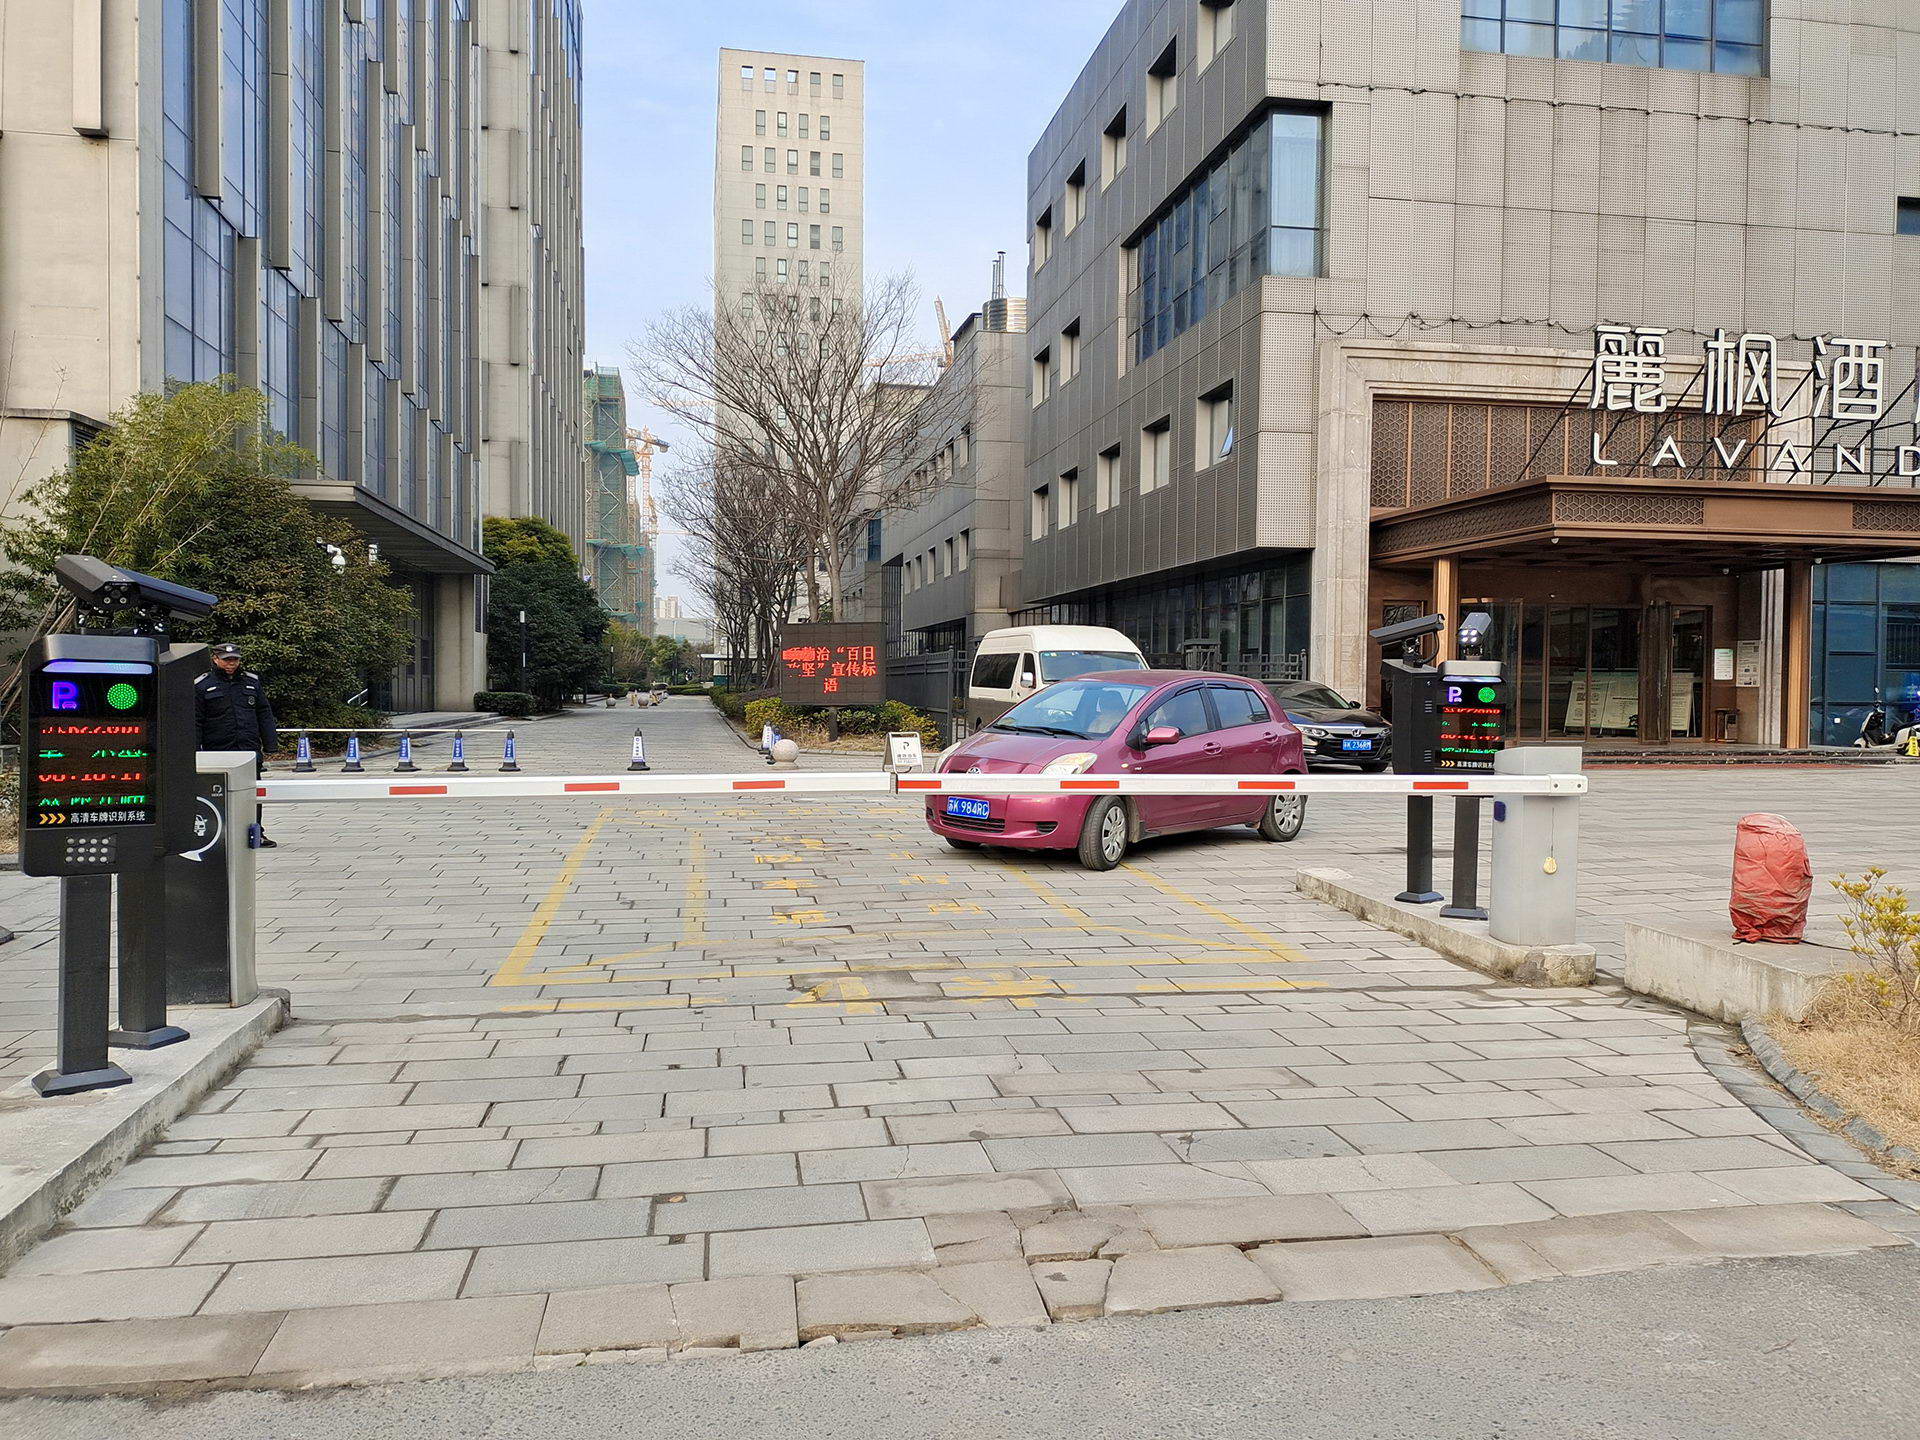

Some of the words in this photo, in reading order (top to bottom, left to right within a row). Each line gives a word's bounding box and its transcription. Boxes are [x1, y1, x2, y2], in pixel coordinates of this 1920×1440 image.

[1590, 325, 1920, 423] 麗枫酒
[823, 678, 838, 693] 语
[70, 810, 146, 824] 高清车牌识别系统
